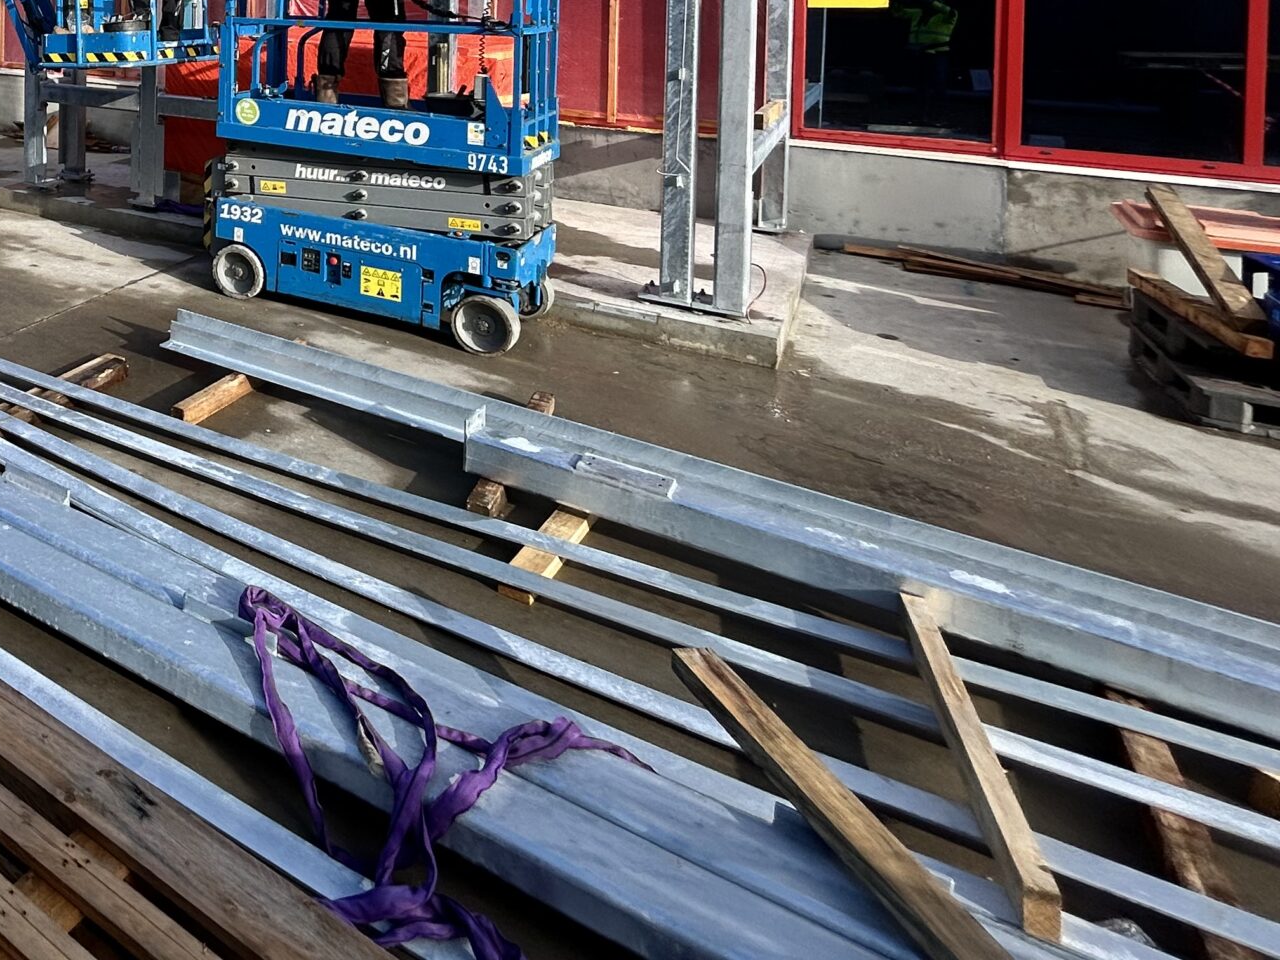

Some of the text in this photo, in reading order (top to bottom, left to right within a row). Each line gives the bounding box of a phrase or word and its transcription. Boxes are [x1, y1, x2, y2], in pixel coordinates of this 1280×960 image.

[285, 108, 430, 146] mateco
[467, 153, 508, 174] 9743
[371, 172, 446, 190] mateco
[220, 203, 263, 224] 1932
[280, 224, 417, 261] www.mateco.nl
